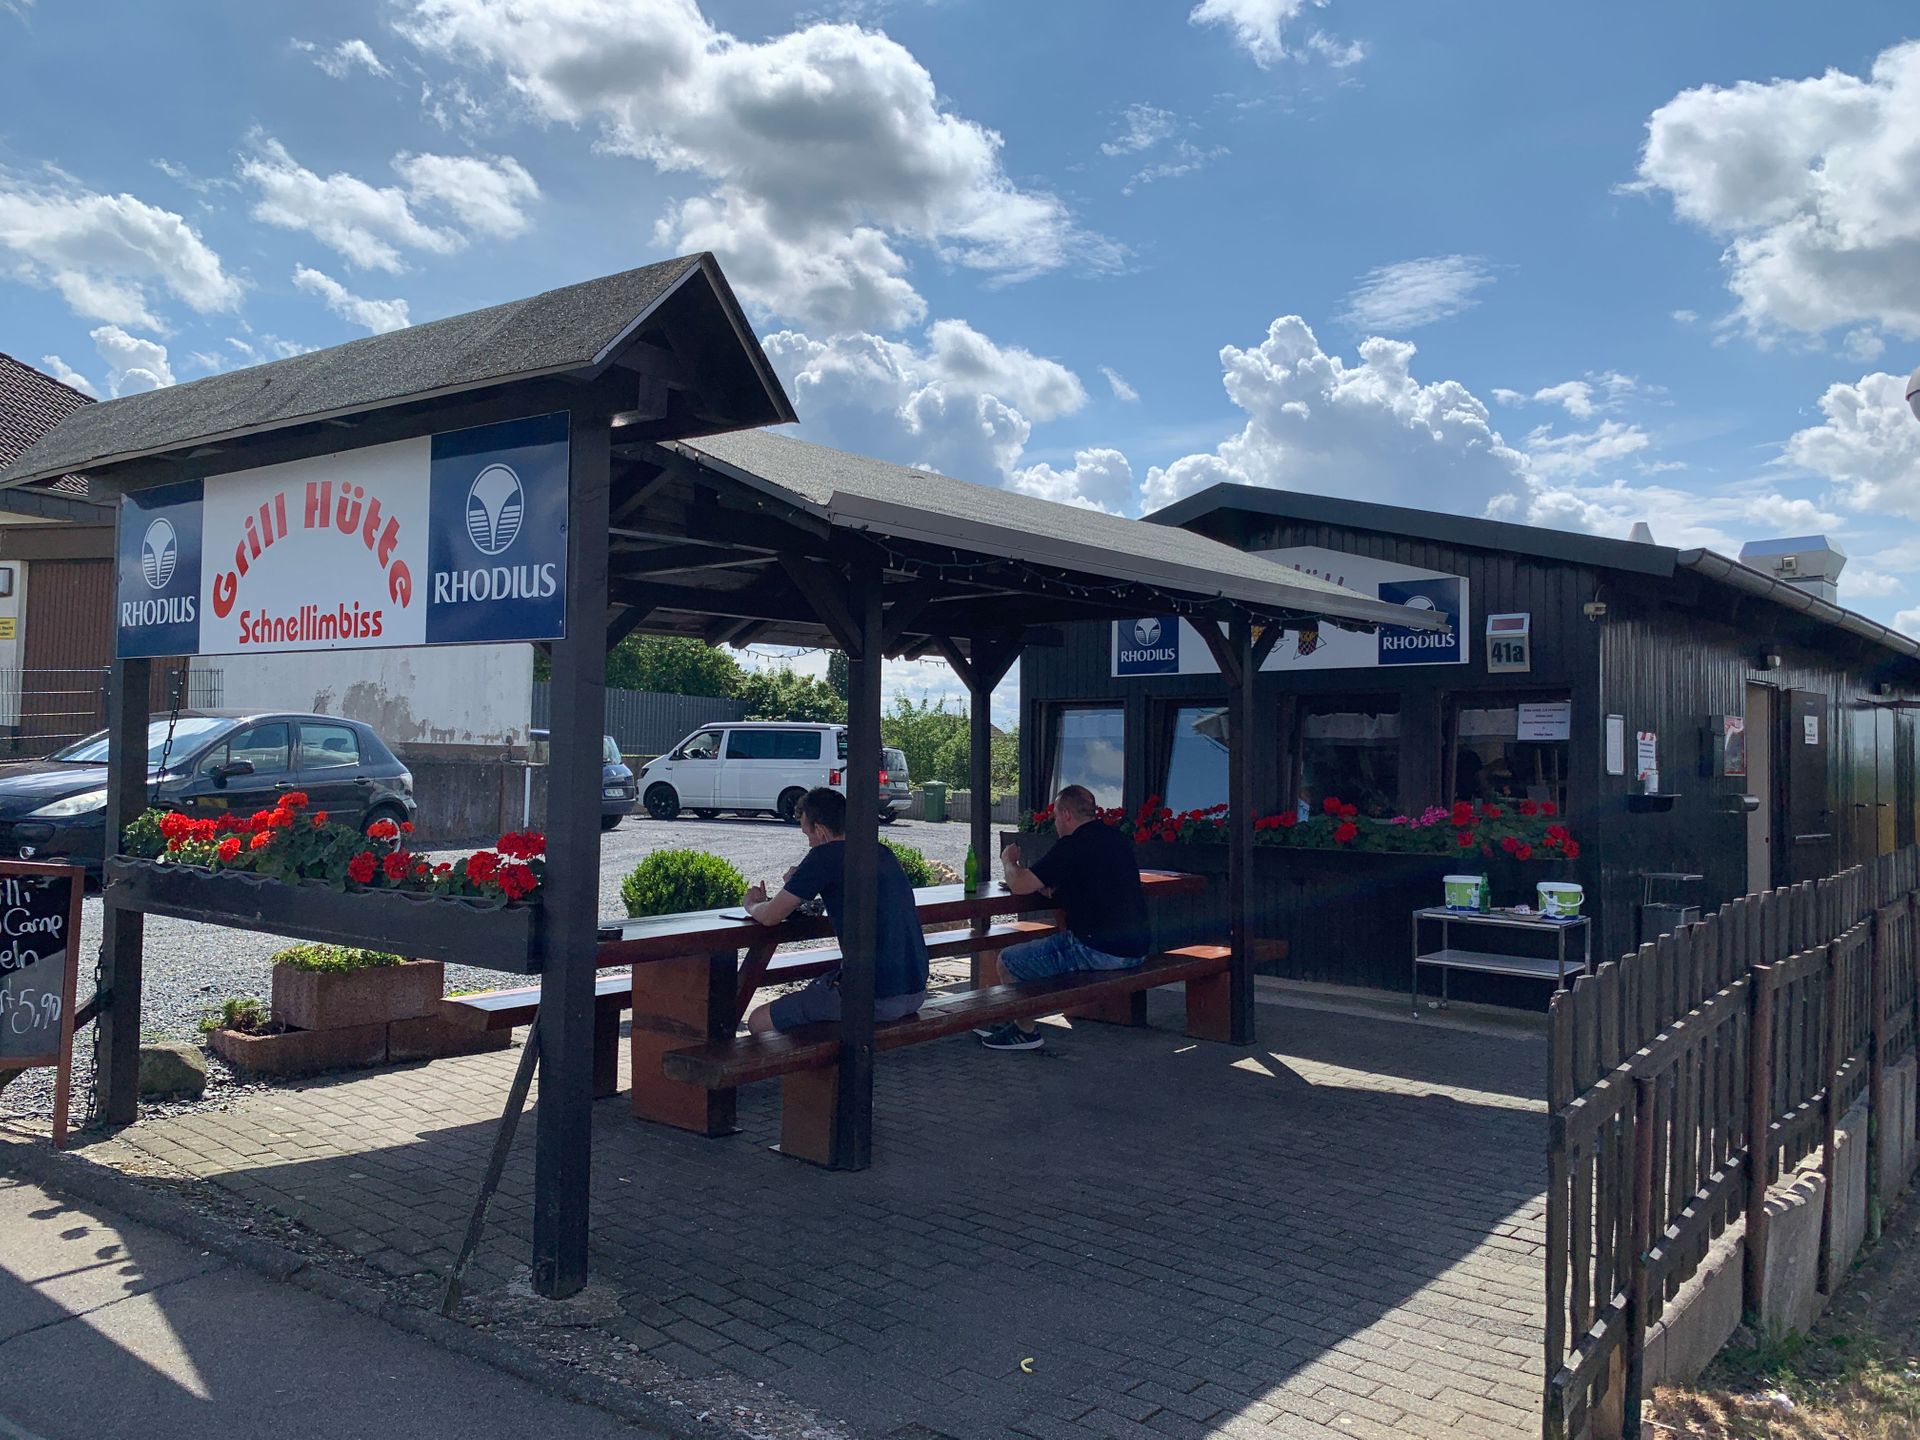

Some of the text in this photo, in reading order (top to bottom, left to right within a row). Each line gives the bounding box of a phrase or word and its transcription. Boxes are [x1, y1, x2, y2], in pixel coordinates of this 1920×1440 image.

[213, 481, 412, 618] Grill Hütte
[433, 562, 557, 604] RHODIUS
[121, 595, 195, 628] RHODIUS
[239, 601, 383, 644] Schnellimbiss
[1120, 648, 1176, 663] RHODIUS
[1383, 633, 1456, 650] RHODIUS
[1491, 642, 1524, 663] 41a
